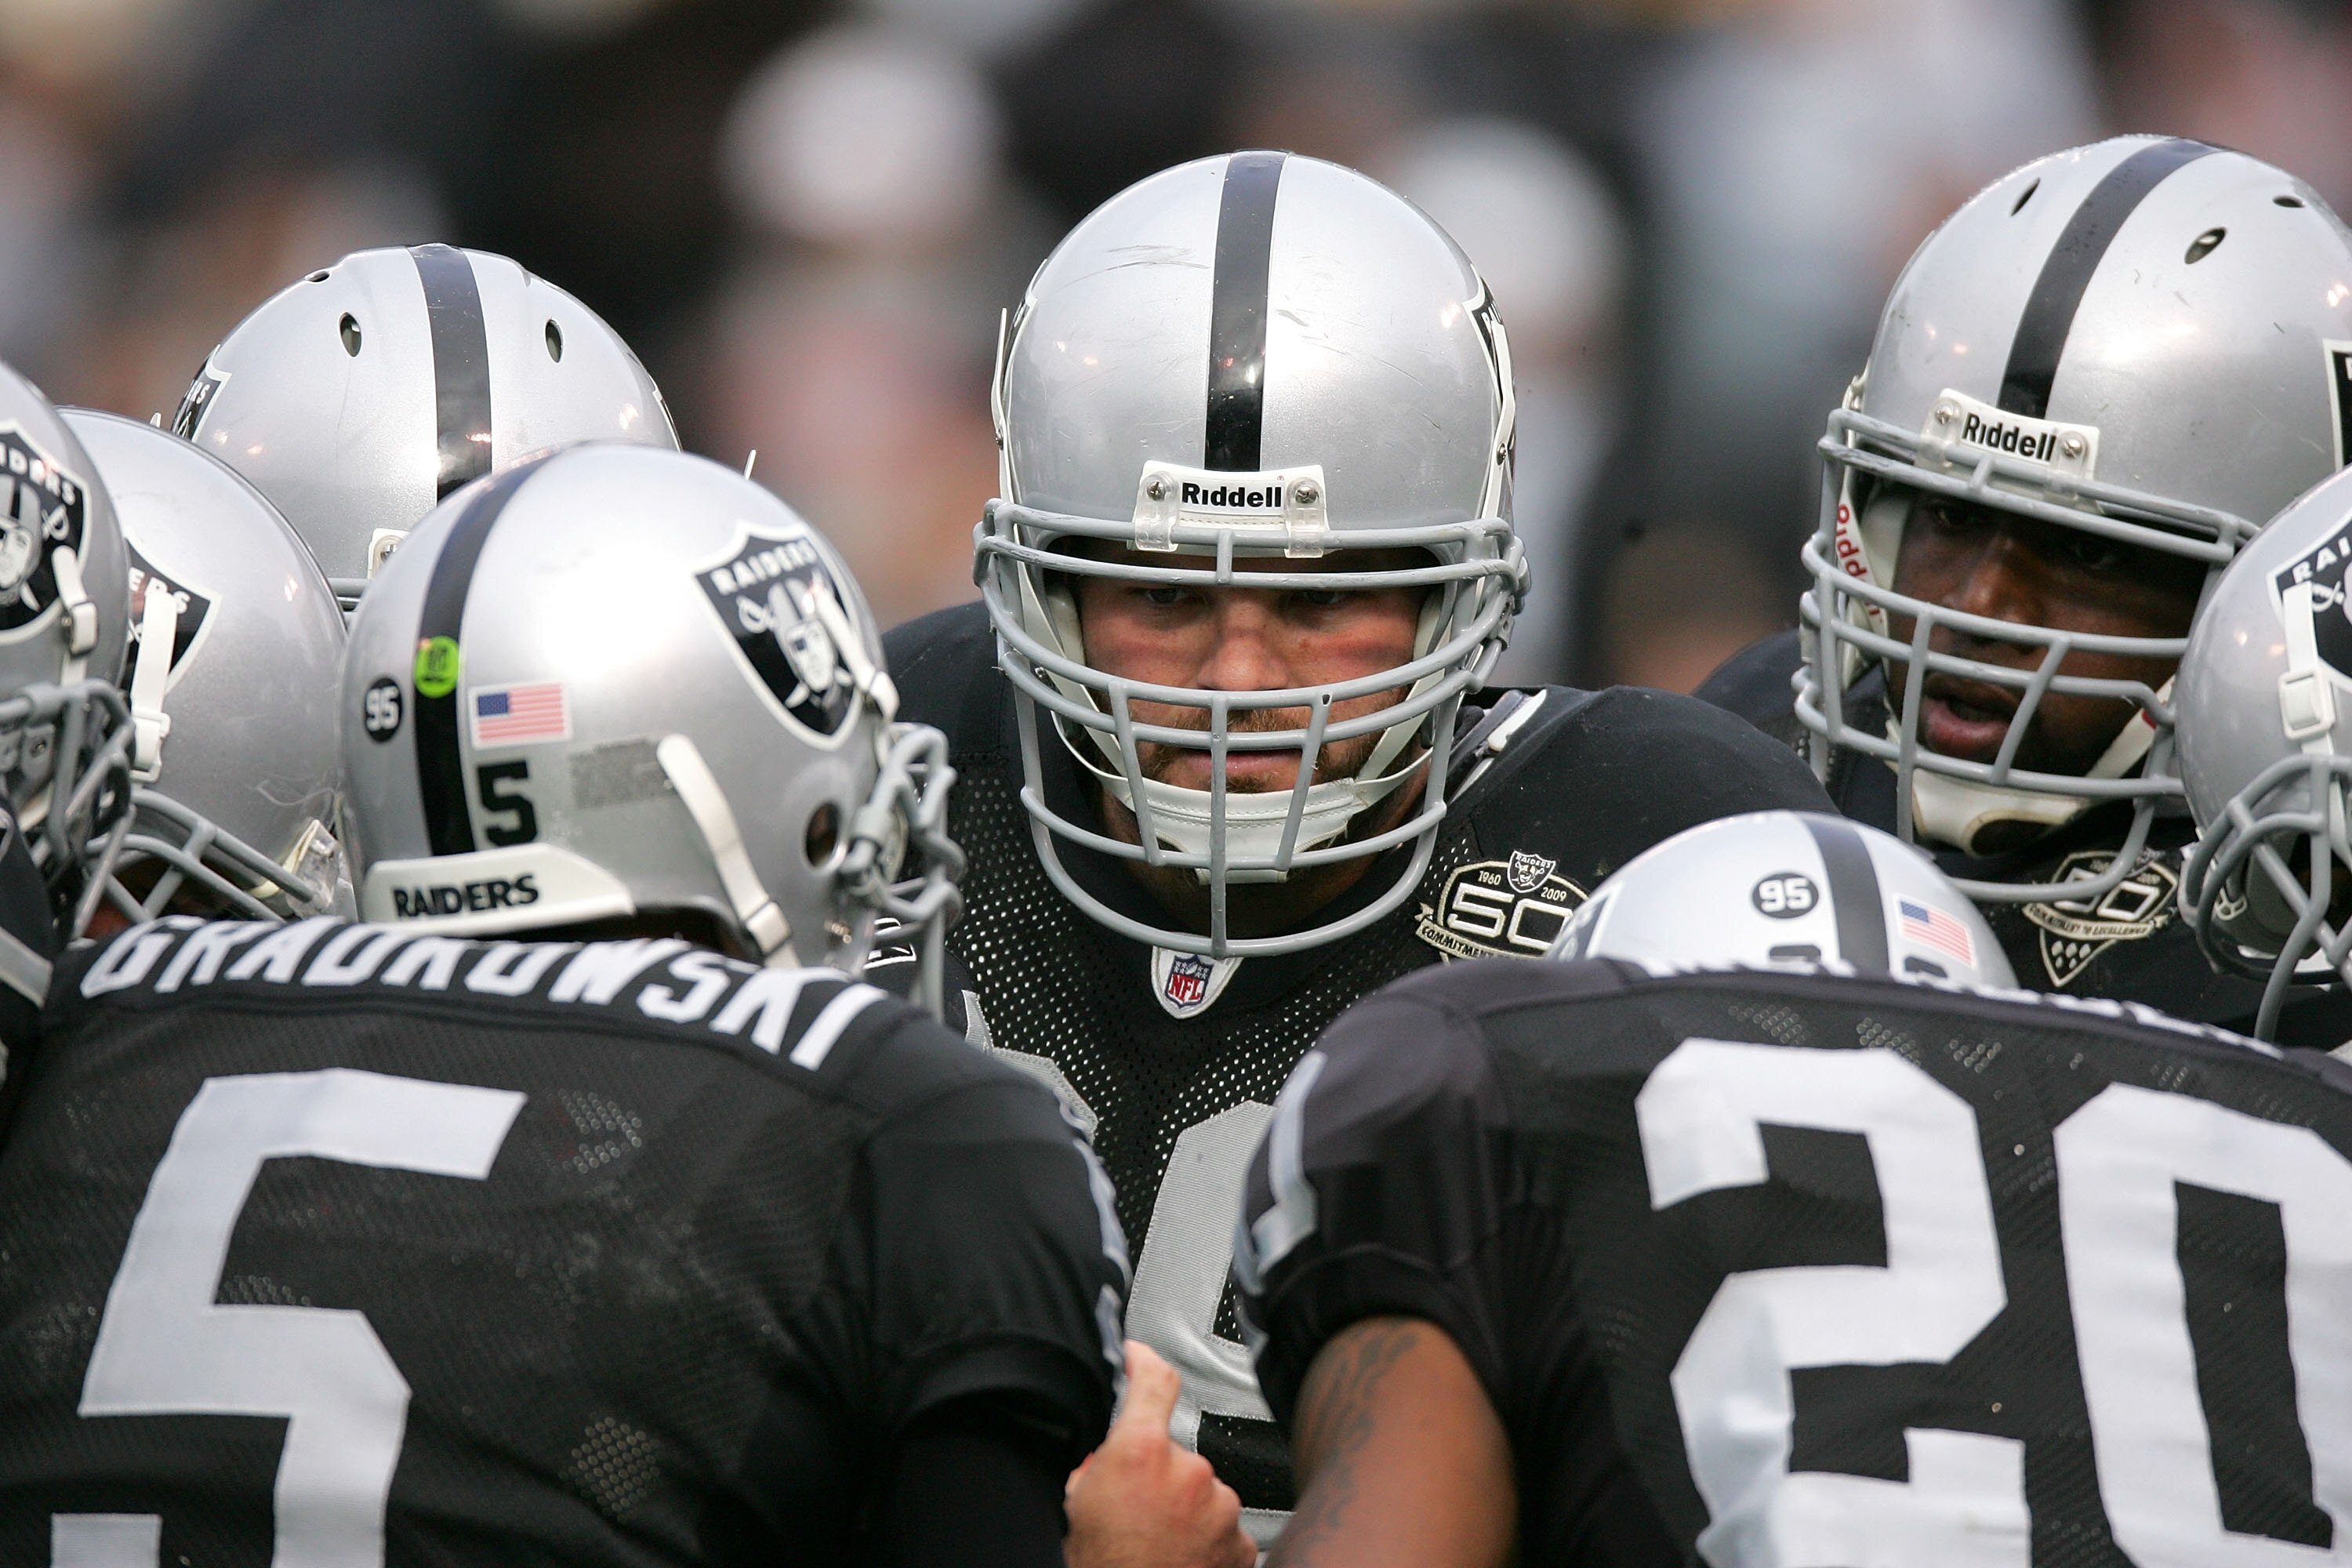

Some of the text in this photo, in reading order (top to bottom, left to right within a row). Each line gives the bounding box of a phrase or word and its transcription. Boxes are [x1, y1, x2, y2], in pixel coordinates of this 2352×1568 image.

[1962, 412, 2056, 461] Riddell
[1181, 482, 1282, 508] Riddell
[710, 539, 818, 596] RAIDERS
[366, 685, 399, 731] 95
[477, 759, 539, 847] 5
[1515, 854, 1551, 868] RAIDERS
[394, 875, 539, 917] RAIDERS
[1477, 870, 1566, 902] 1960 2009
[1759, 877, 1812, 913] 95
[1447, 882, 1573, 953] 50
[1168, 973, 1202, 1002] NFL
[51, 1068, 528, 1568] 5
[1635, 1036, 2352, 1568] 20
